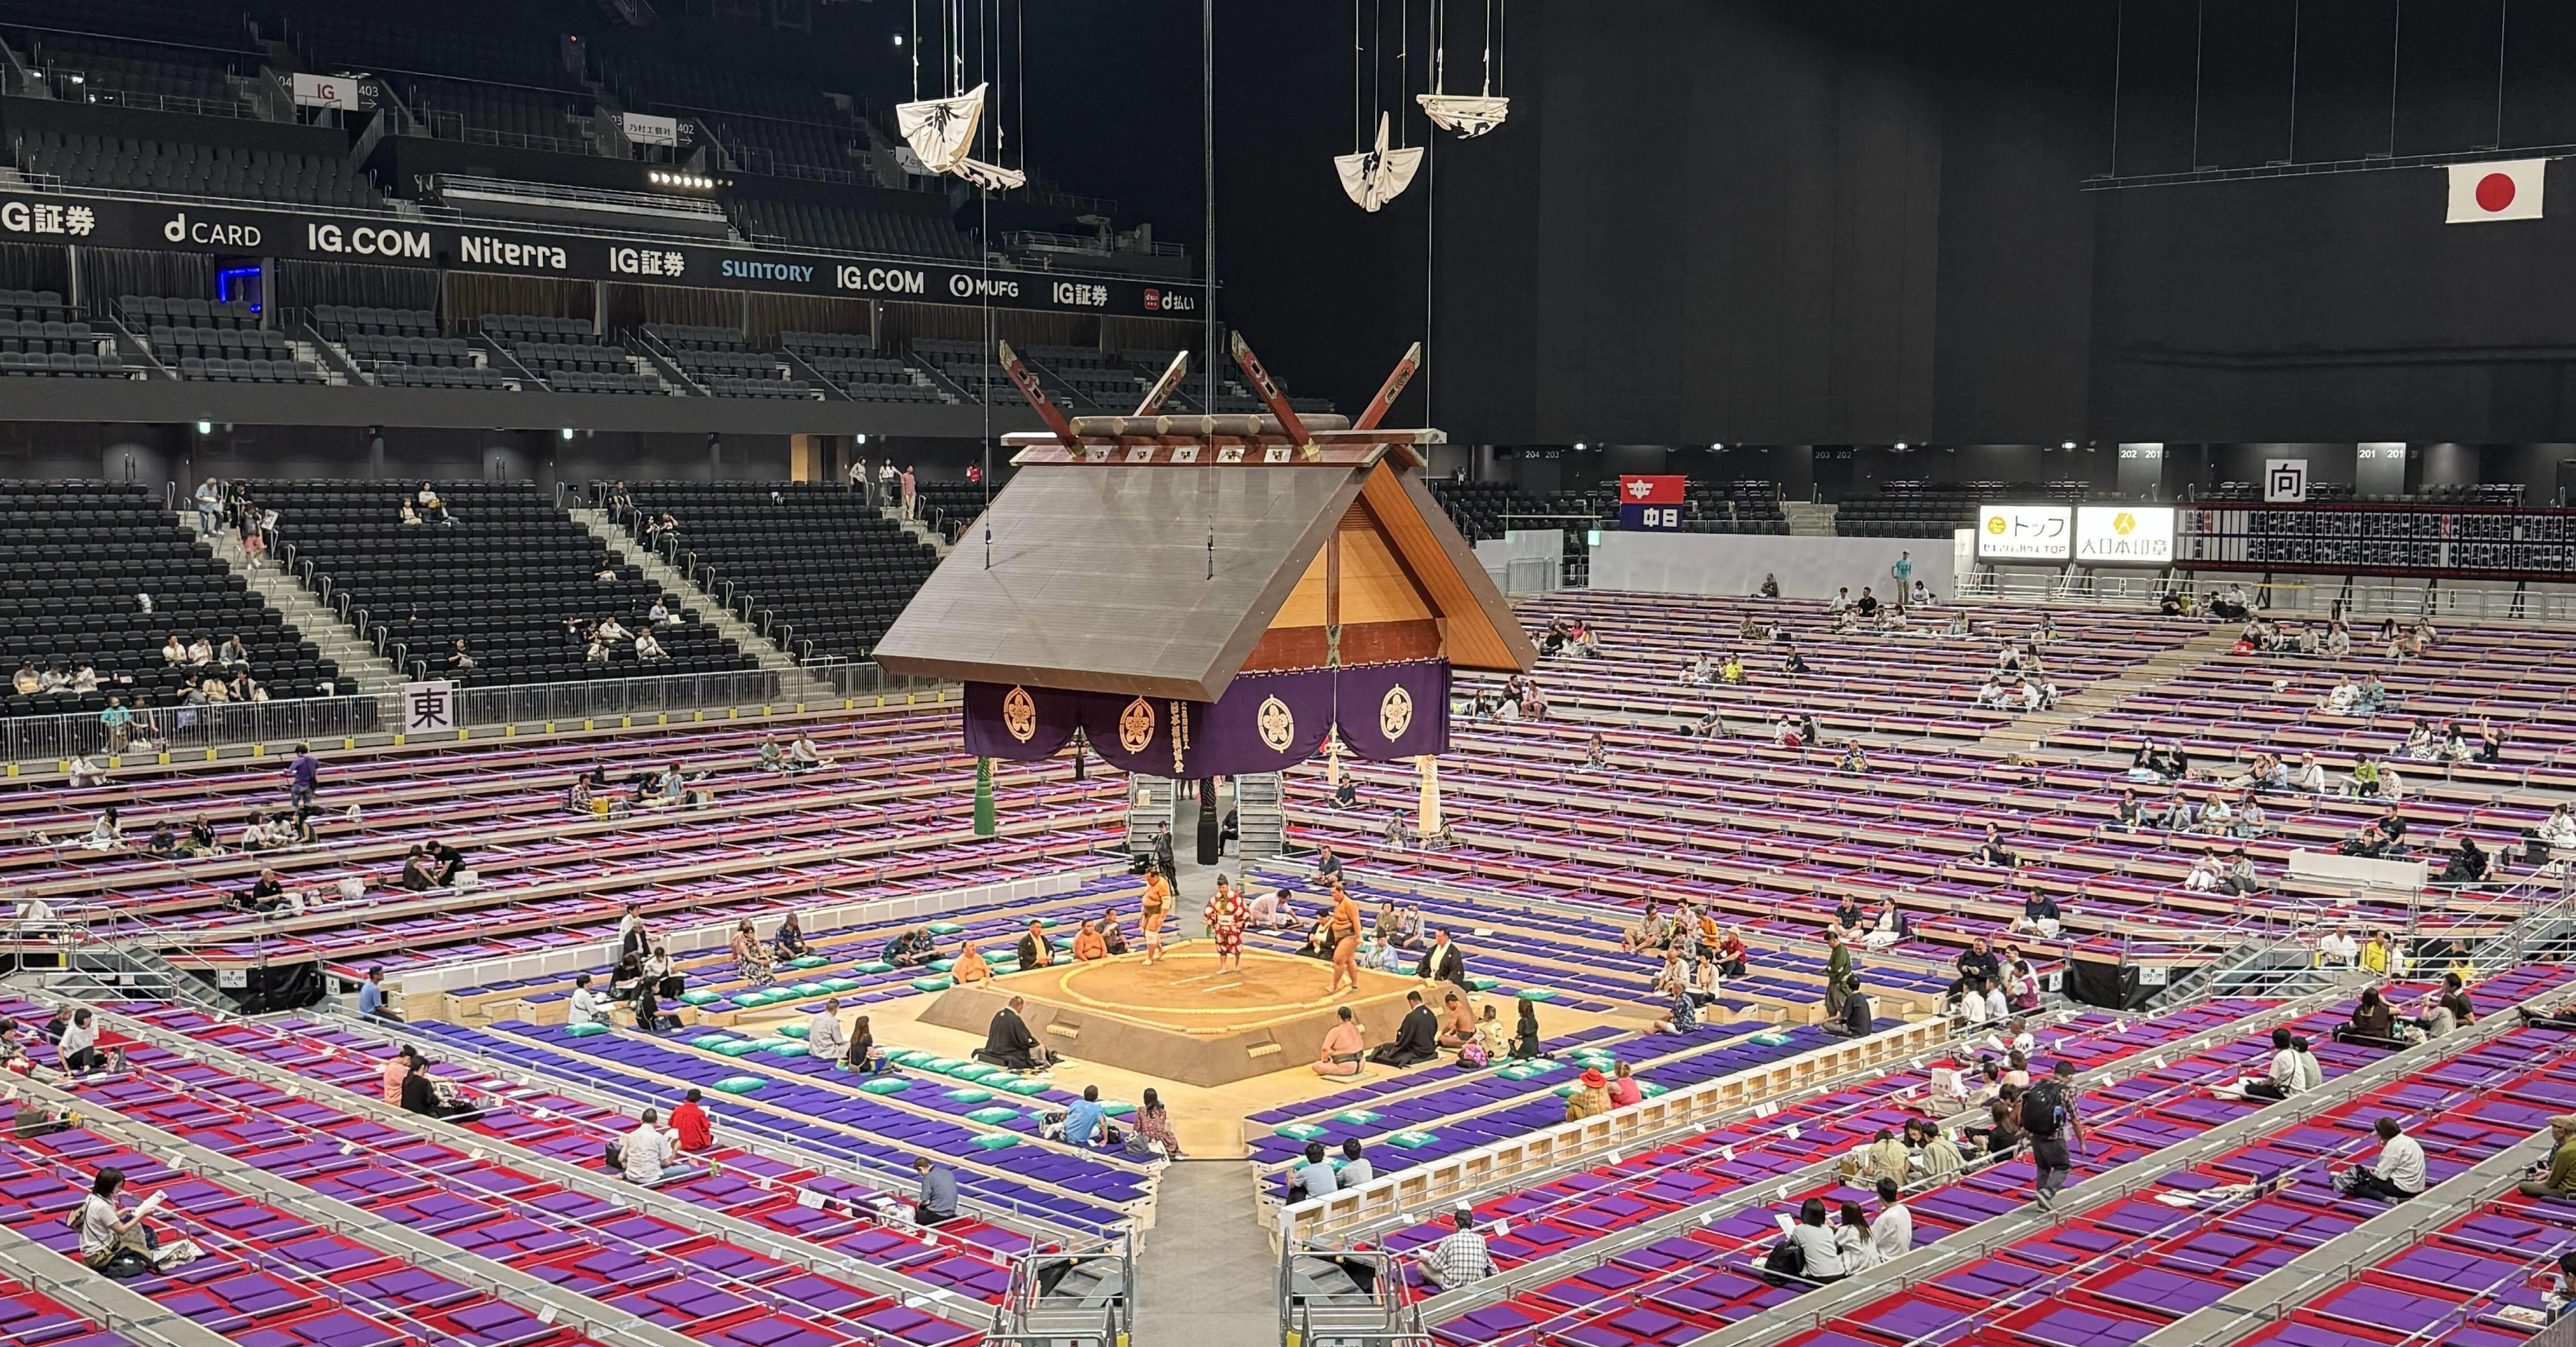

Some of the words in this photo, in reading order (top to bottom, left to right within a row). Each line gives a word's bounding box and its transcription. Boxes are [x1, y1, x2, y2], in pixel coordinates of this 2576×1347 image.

[278, 76, 292, 87] 04
[358, 85, 379, 97] 403
[317, 84, 334, 99] IG
[678, 123, 694, 134] 402
[191, 223, 261, 246] CARD
[309, 224, 431, 258] IG.COM
[461, 236, 566, 269] Niterra
[610, 247, 685, 277] IG証券
[837, 265, 924, 294] IG.COM
[976, 279, 1019, 297] MUFG
[1054, 282, 1108, 307] IG証券
[1162, 291, 1194, 310] d払い
[1525, 451, 1540, 459] 204
[1546, 451, 1559, 459] 203
[2121, 450, 2137, 458] 202
[2145, 450, 2160, 459] 201
[2359, 449, 2376, 459] 201
[2387, 449, 2403, 459] 201
[2271, 463, 2301, 497] 向
[1644, 507, 1677, 527] 中日
[2045, 545, 2066, 554] TOP
[410, 688, 448, 728] 東
